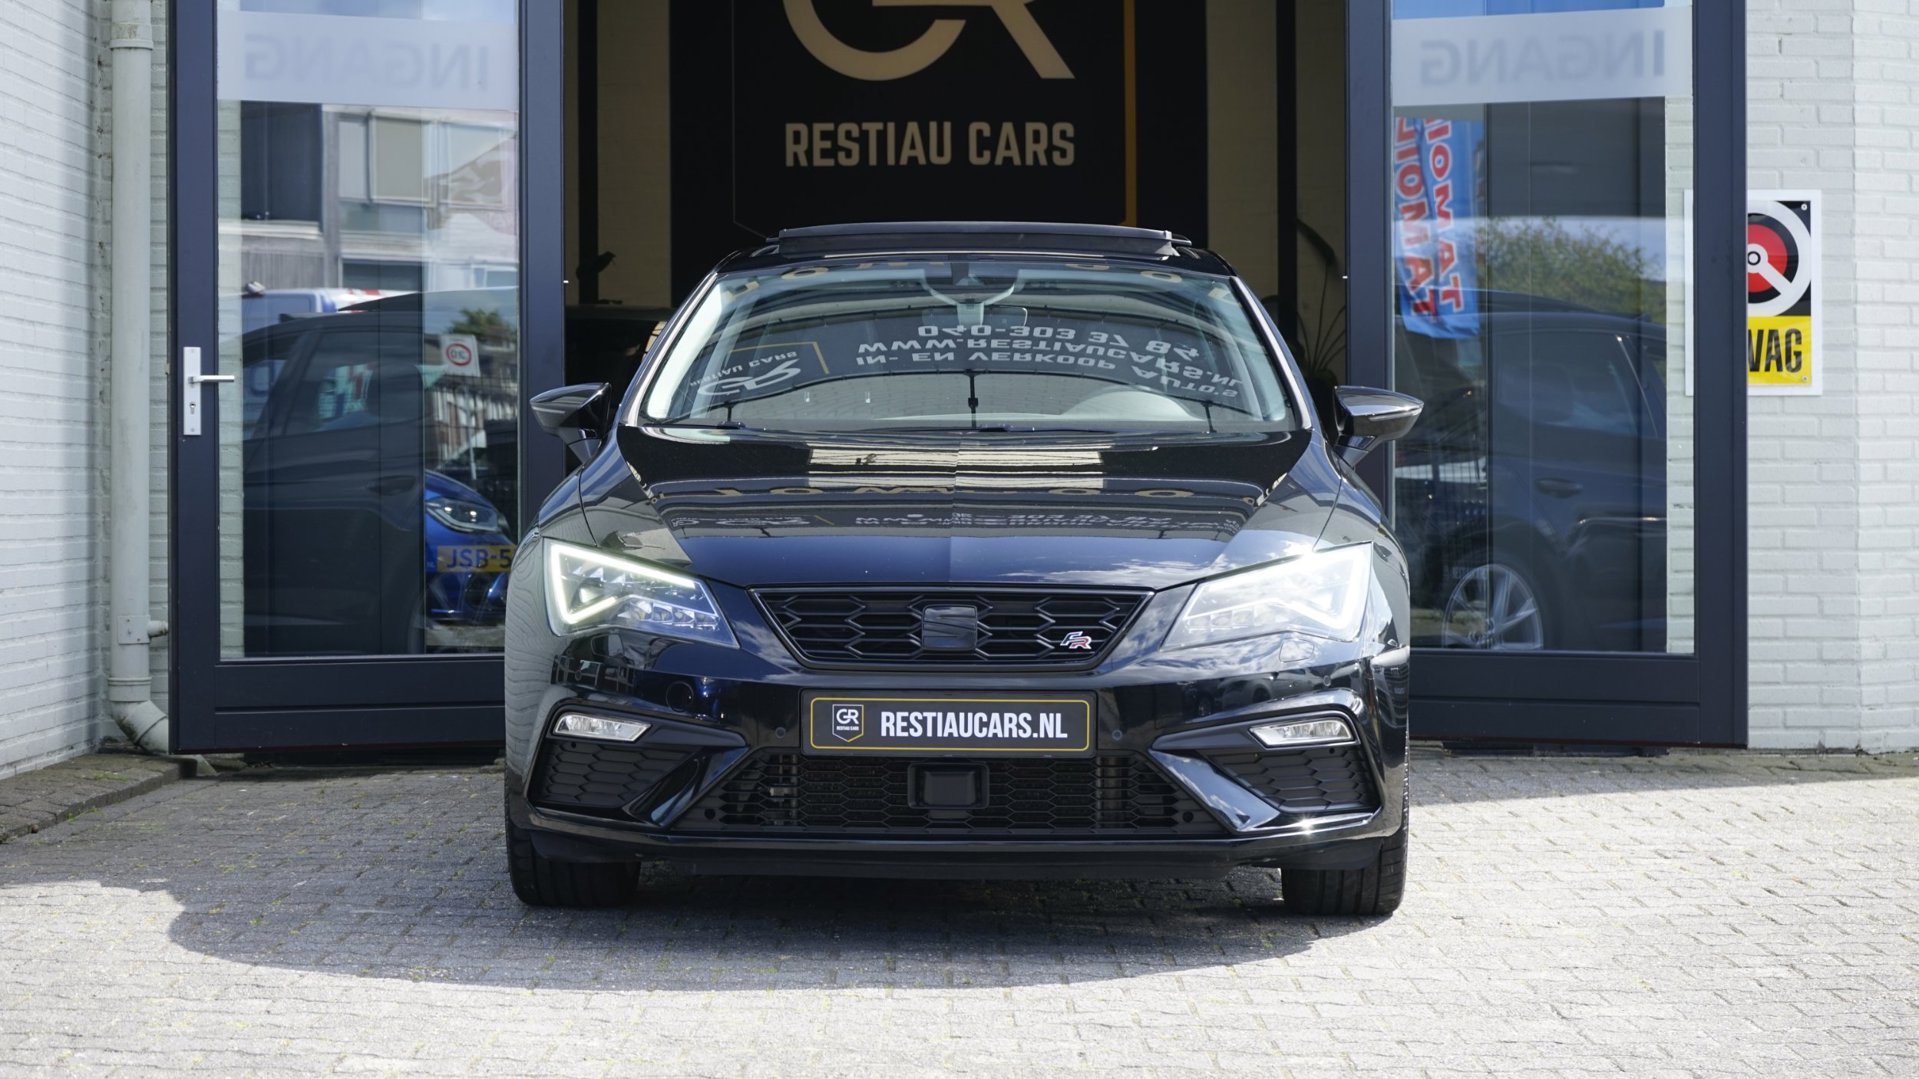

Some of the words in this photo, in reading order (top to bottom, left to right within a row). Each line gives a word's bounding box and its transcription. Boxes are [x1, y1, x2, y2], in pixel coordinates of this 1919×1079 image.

[785, 121, 952, 167] RESTIAU
[968, 121, 1076, 166] CARS
[1747, 328, 1802, 373] VAG
[447, 548, 511, 569] JSB-5
[1060, 630, 1092, 650] FR
[836, 708, 860, 725] GR
[880, 711, 1069, 739] RESTIAUCARS.NL
